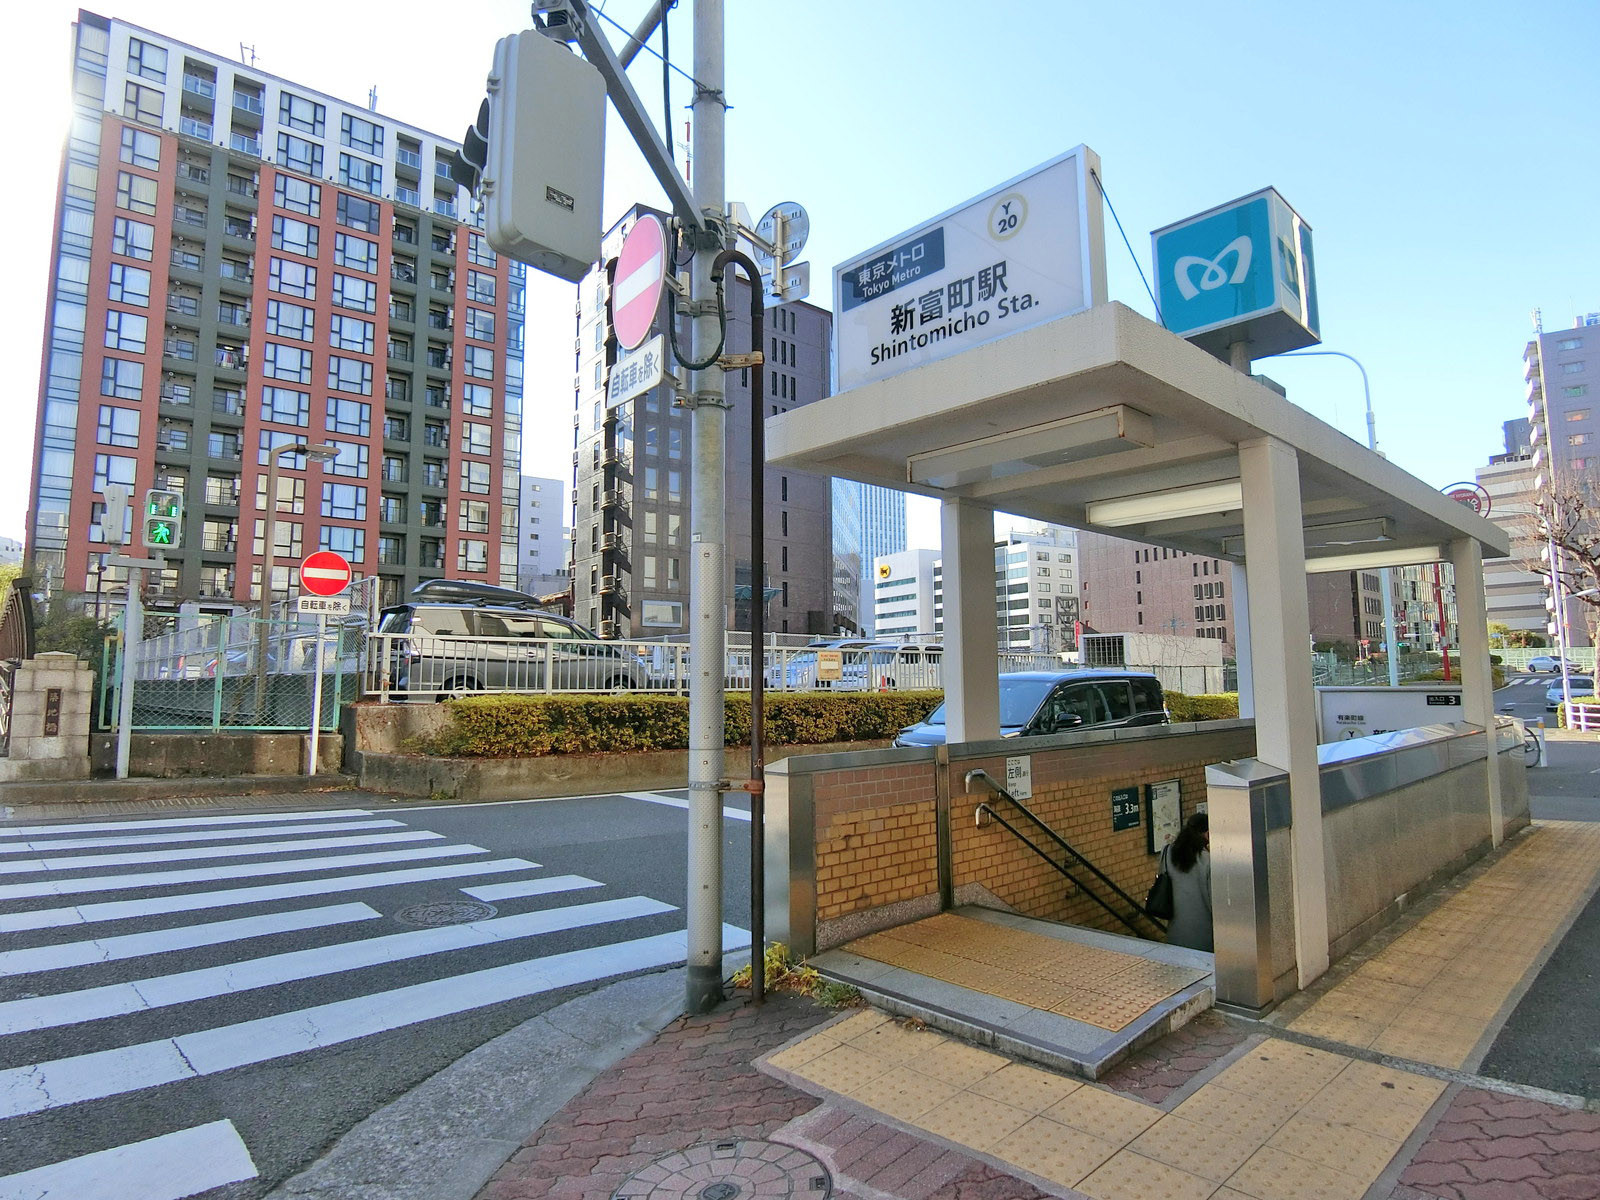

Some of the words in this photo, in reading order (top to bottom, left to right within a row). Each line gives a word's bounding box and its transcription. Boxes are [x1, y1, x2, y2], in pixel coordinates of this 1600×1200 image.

[998, 214, 1018, 234] 20
[1002, 201, 1012, 215] Y
[858, 242, 925, 287] 東京メトロ
[862, 281, 890, 298] Tokyo
[892, 266, 921, 286] Metro
[890, 260, 1009, 336] 新富町駅
[871, 310, 990, 365] Shintomicho
[997, 293, 1040, 319] Sta.
[611, 351, 659, 399] 自転車を除く
[301, 600, 347, 611] 自転車を除く
[1448, 695, 1456, 705] 3
